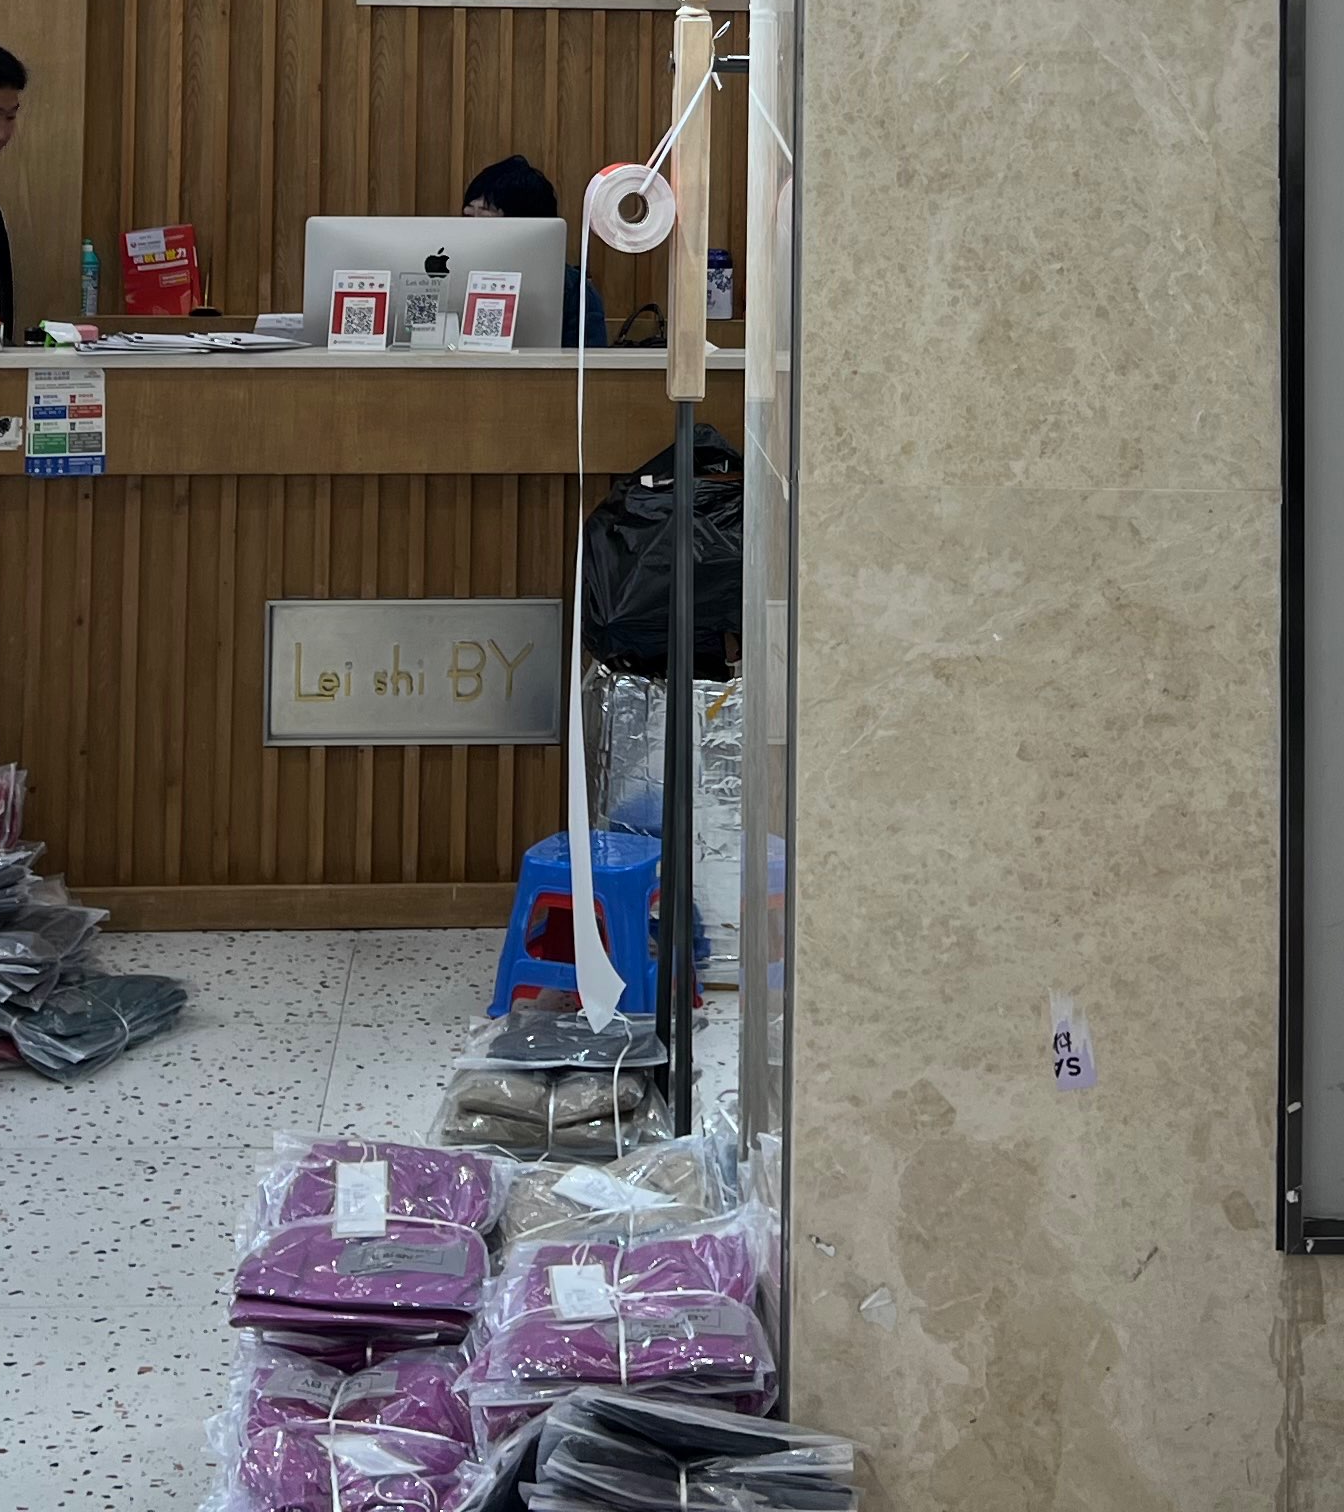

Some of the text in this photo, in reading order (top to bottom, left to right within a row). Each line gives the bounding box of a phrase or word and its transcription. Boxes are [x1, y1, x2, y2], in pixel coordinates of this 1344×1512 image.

[295, 639, 535, 702] Lei shi BY
